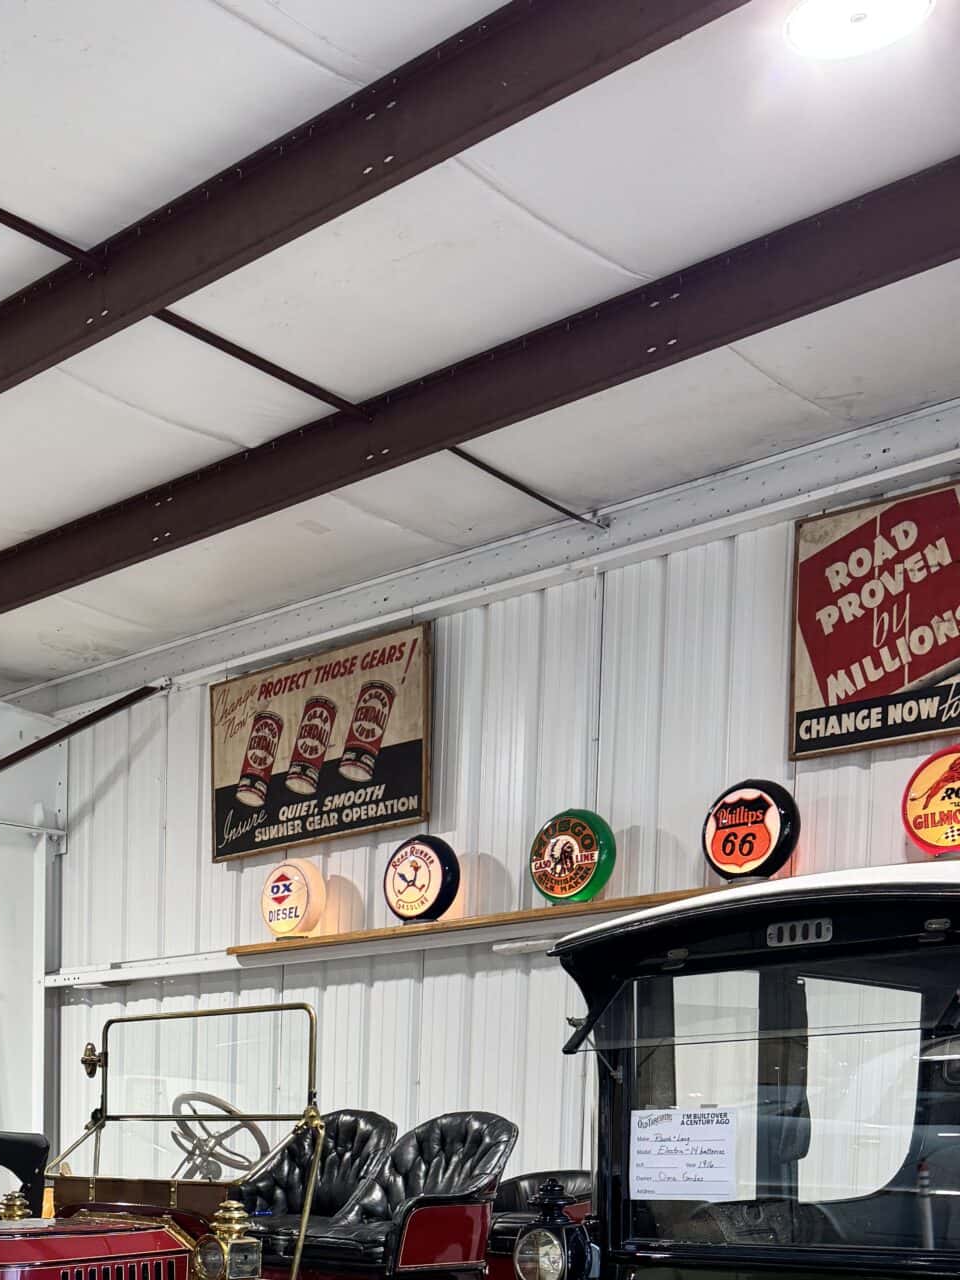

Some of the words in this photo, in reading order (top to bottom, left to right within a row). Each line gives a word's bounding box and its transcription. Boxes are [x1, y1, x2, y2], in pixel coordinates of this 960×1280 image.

[825, 520, 918, 592] ROAD
[816, 537, 952, 636] PROVEN
[872, 593, 910, 648] by
[258, 669, 312, 700] PROTECT
[314, 655, 358, 687] THOSE
[360, 638, 418, 685] GEARS!
[214, 684, 257, 725] Change
[799, 706, 882, 740] CHANGE
[887, 696, 940, 725] NOW
[255, 820, 303, 843] SUMMER
[306, 814, 338, 832] GEAR
[342, 795, 418, 822] OPERATION
[278, 799, 318, 822] QUIET,
[323, 784, 386, 811] SMOOTH
[718, 805, 764, 827] Phillips
[218, 808, 268, 849] Insure
[722, 832, 757, 856] 66
[575, 854, 595, 863] LINE
[271, 882, 293, 895] OX
[269, 906, 300, 923] DIESEL
